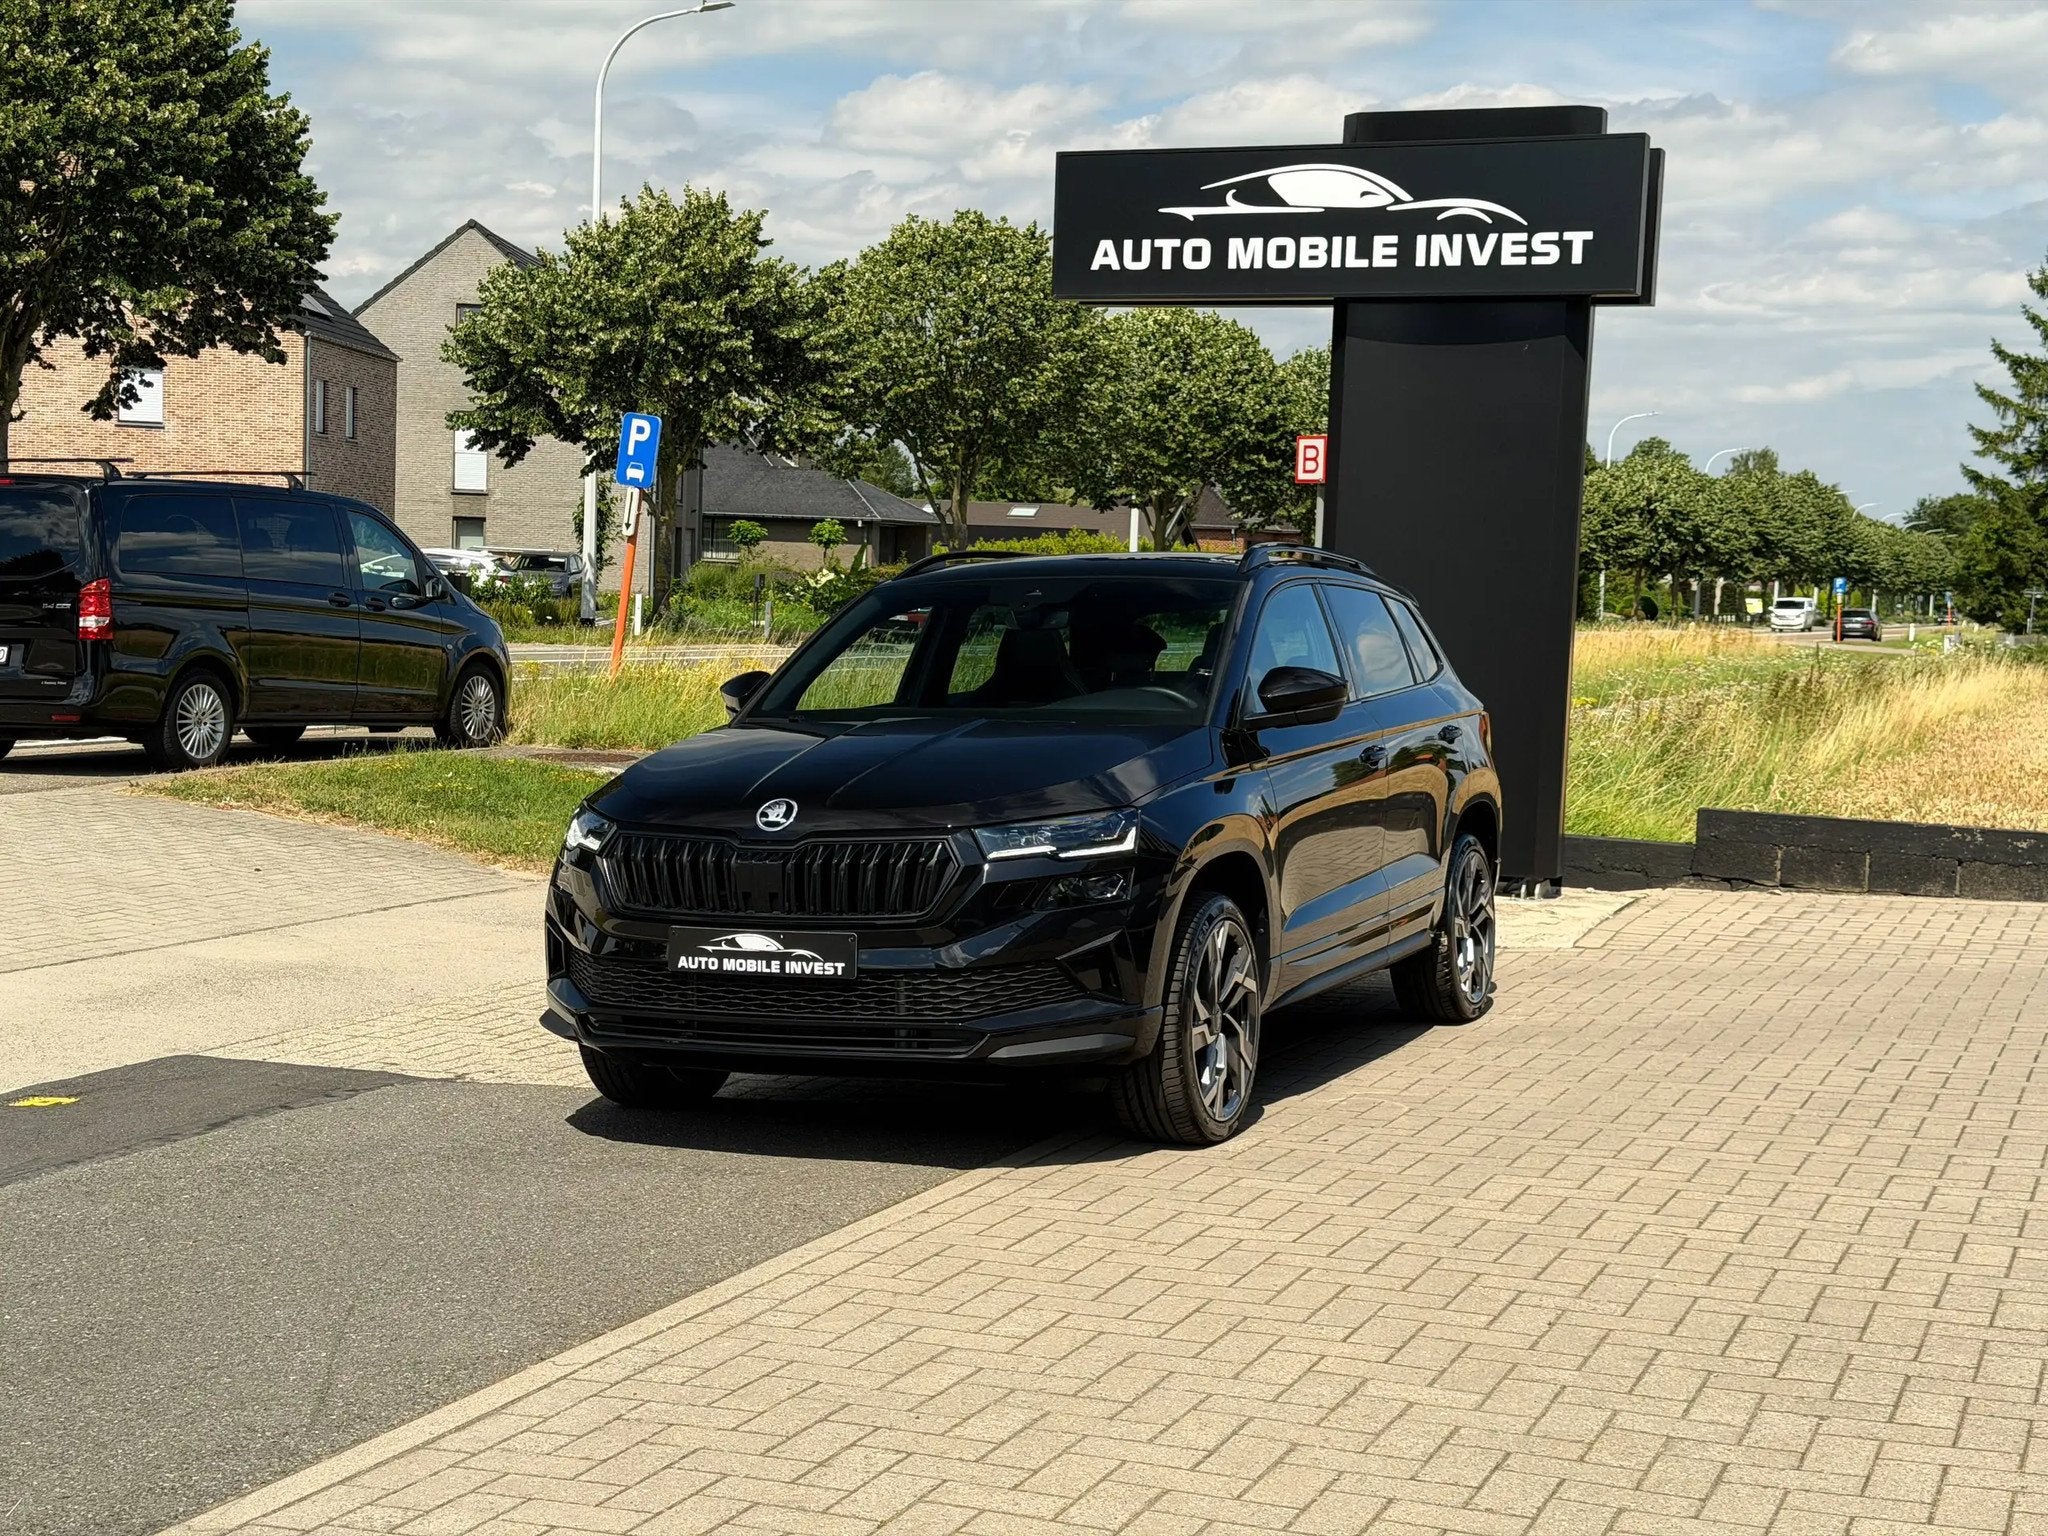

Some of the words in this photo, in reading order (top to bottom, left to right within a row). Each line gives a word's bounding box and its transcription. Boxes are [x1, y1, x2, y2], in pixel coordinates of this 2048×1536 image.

[1091, 238, 1212, 271] AUTO
[1227, 235, 1399, 270] MOBILE
[1415, 231, 1594, 267] INVEST
[627, 418, 651, 456] P
[1302, 445, 1319, 474] B
[677, 955, 719, 971] AUTO
[722, 958, 781, 974] MOBILE
[785, 961, 846, 976] INVEST
